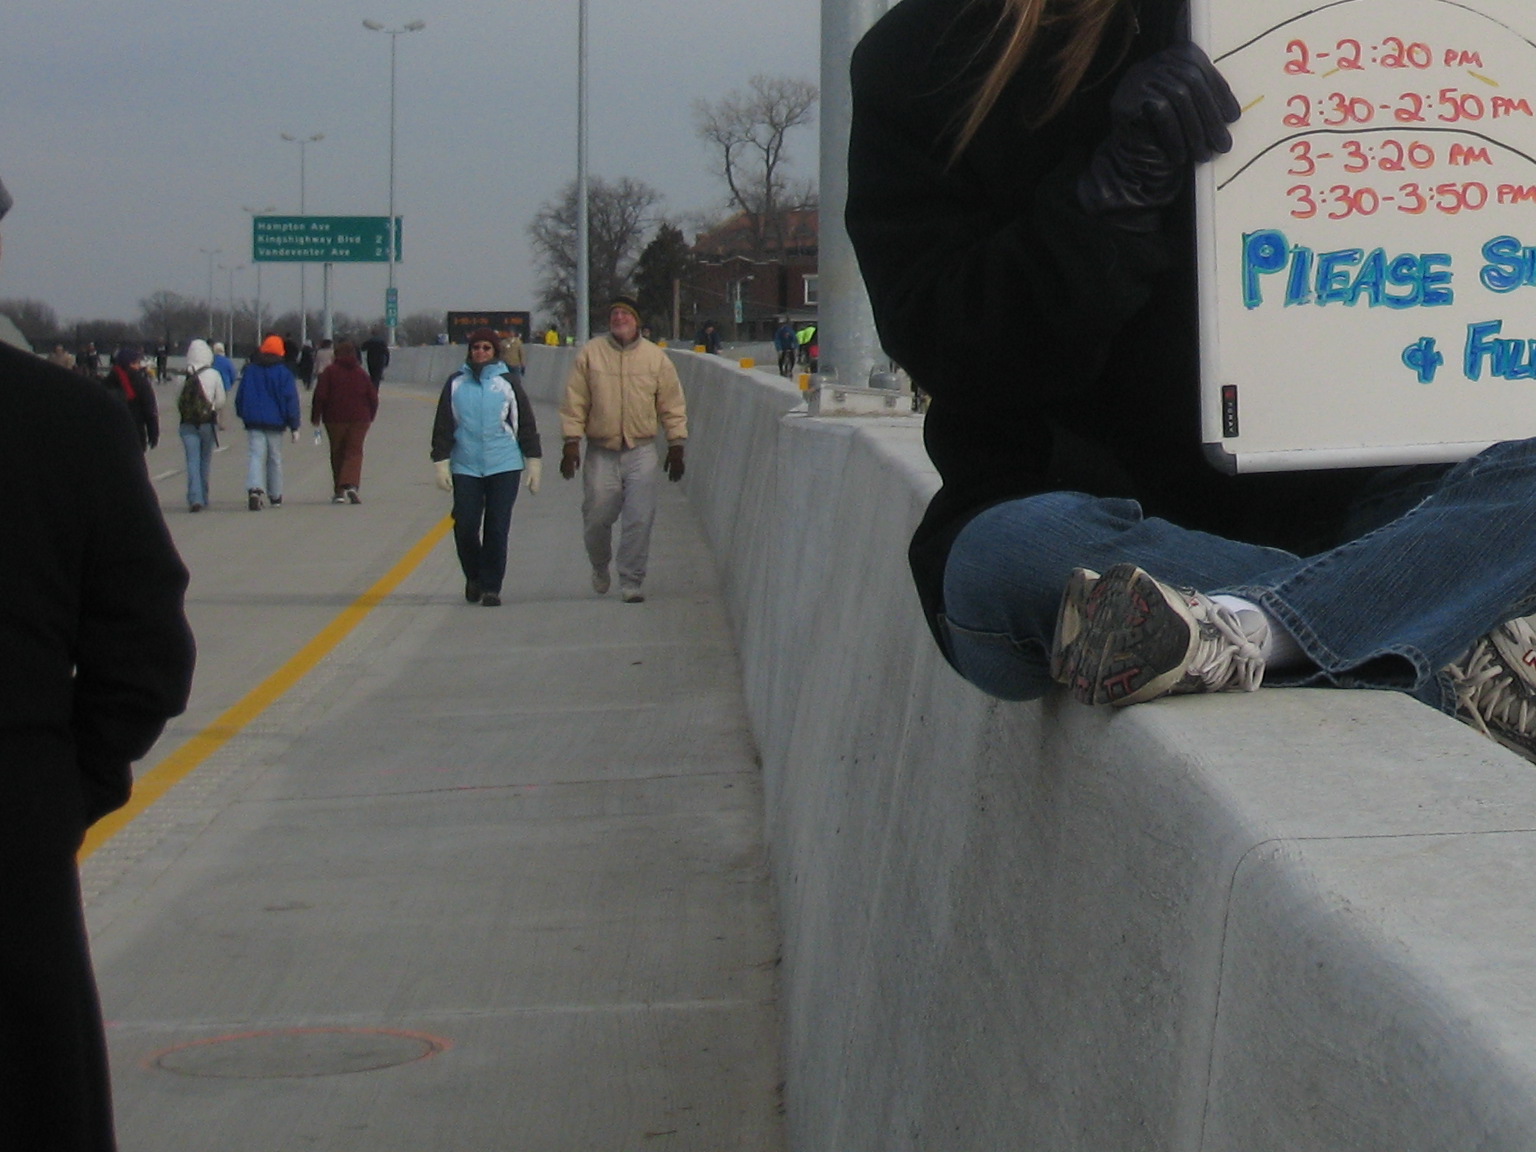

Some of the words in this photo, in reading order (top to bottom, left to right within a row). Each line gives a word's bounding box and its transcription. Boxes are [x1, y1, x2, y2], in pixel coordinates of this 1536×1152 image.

[1283, 37, 1433, 75] 2-2:20
[1444, 49, 1484, 68] PM
[1282, 88, 1485, 128] 2:30-2:50
[1491, 96, 1534, 119] PM
[1287, 140, 1435, 176] 3-3:20
[1448, 143, 1494, 166] PM
[1286, 181, 1488, 220] 3:30-3:50
[257, 222, 306, 232] Hampton
[310, 222, 331, 231] Ave
[337, 234, 361, 244] Blvd
[331, 248, 351, 256] Ave
